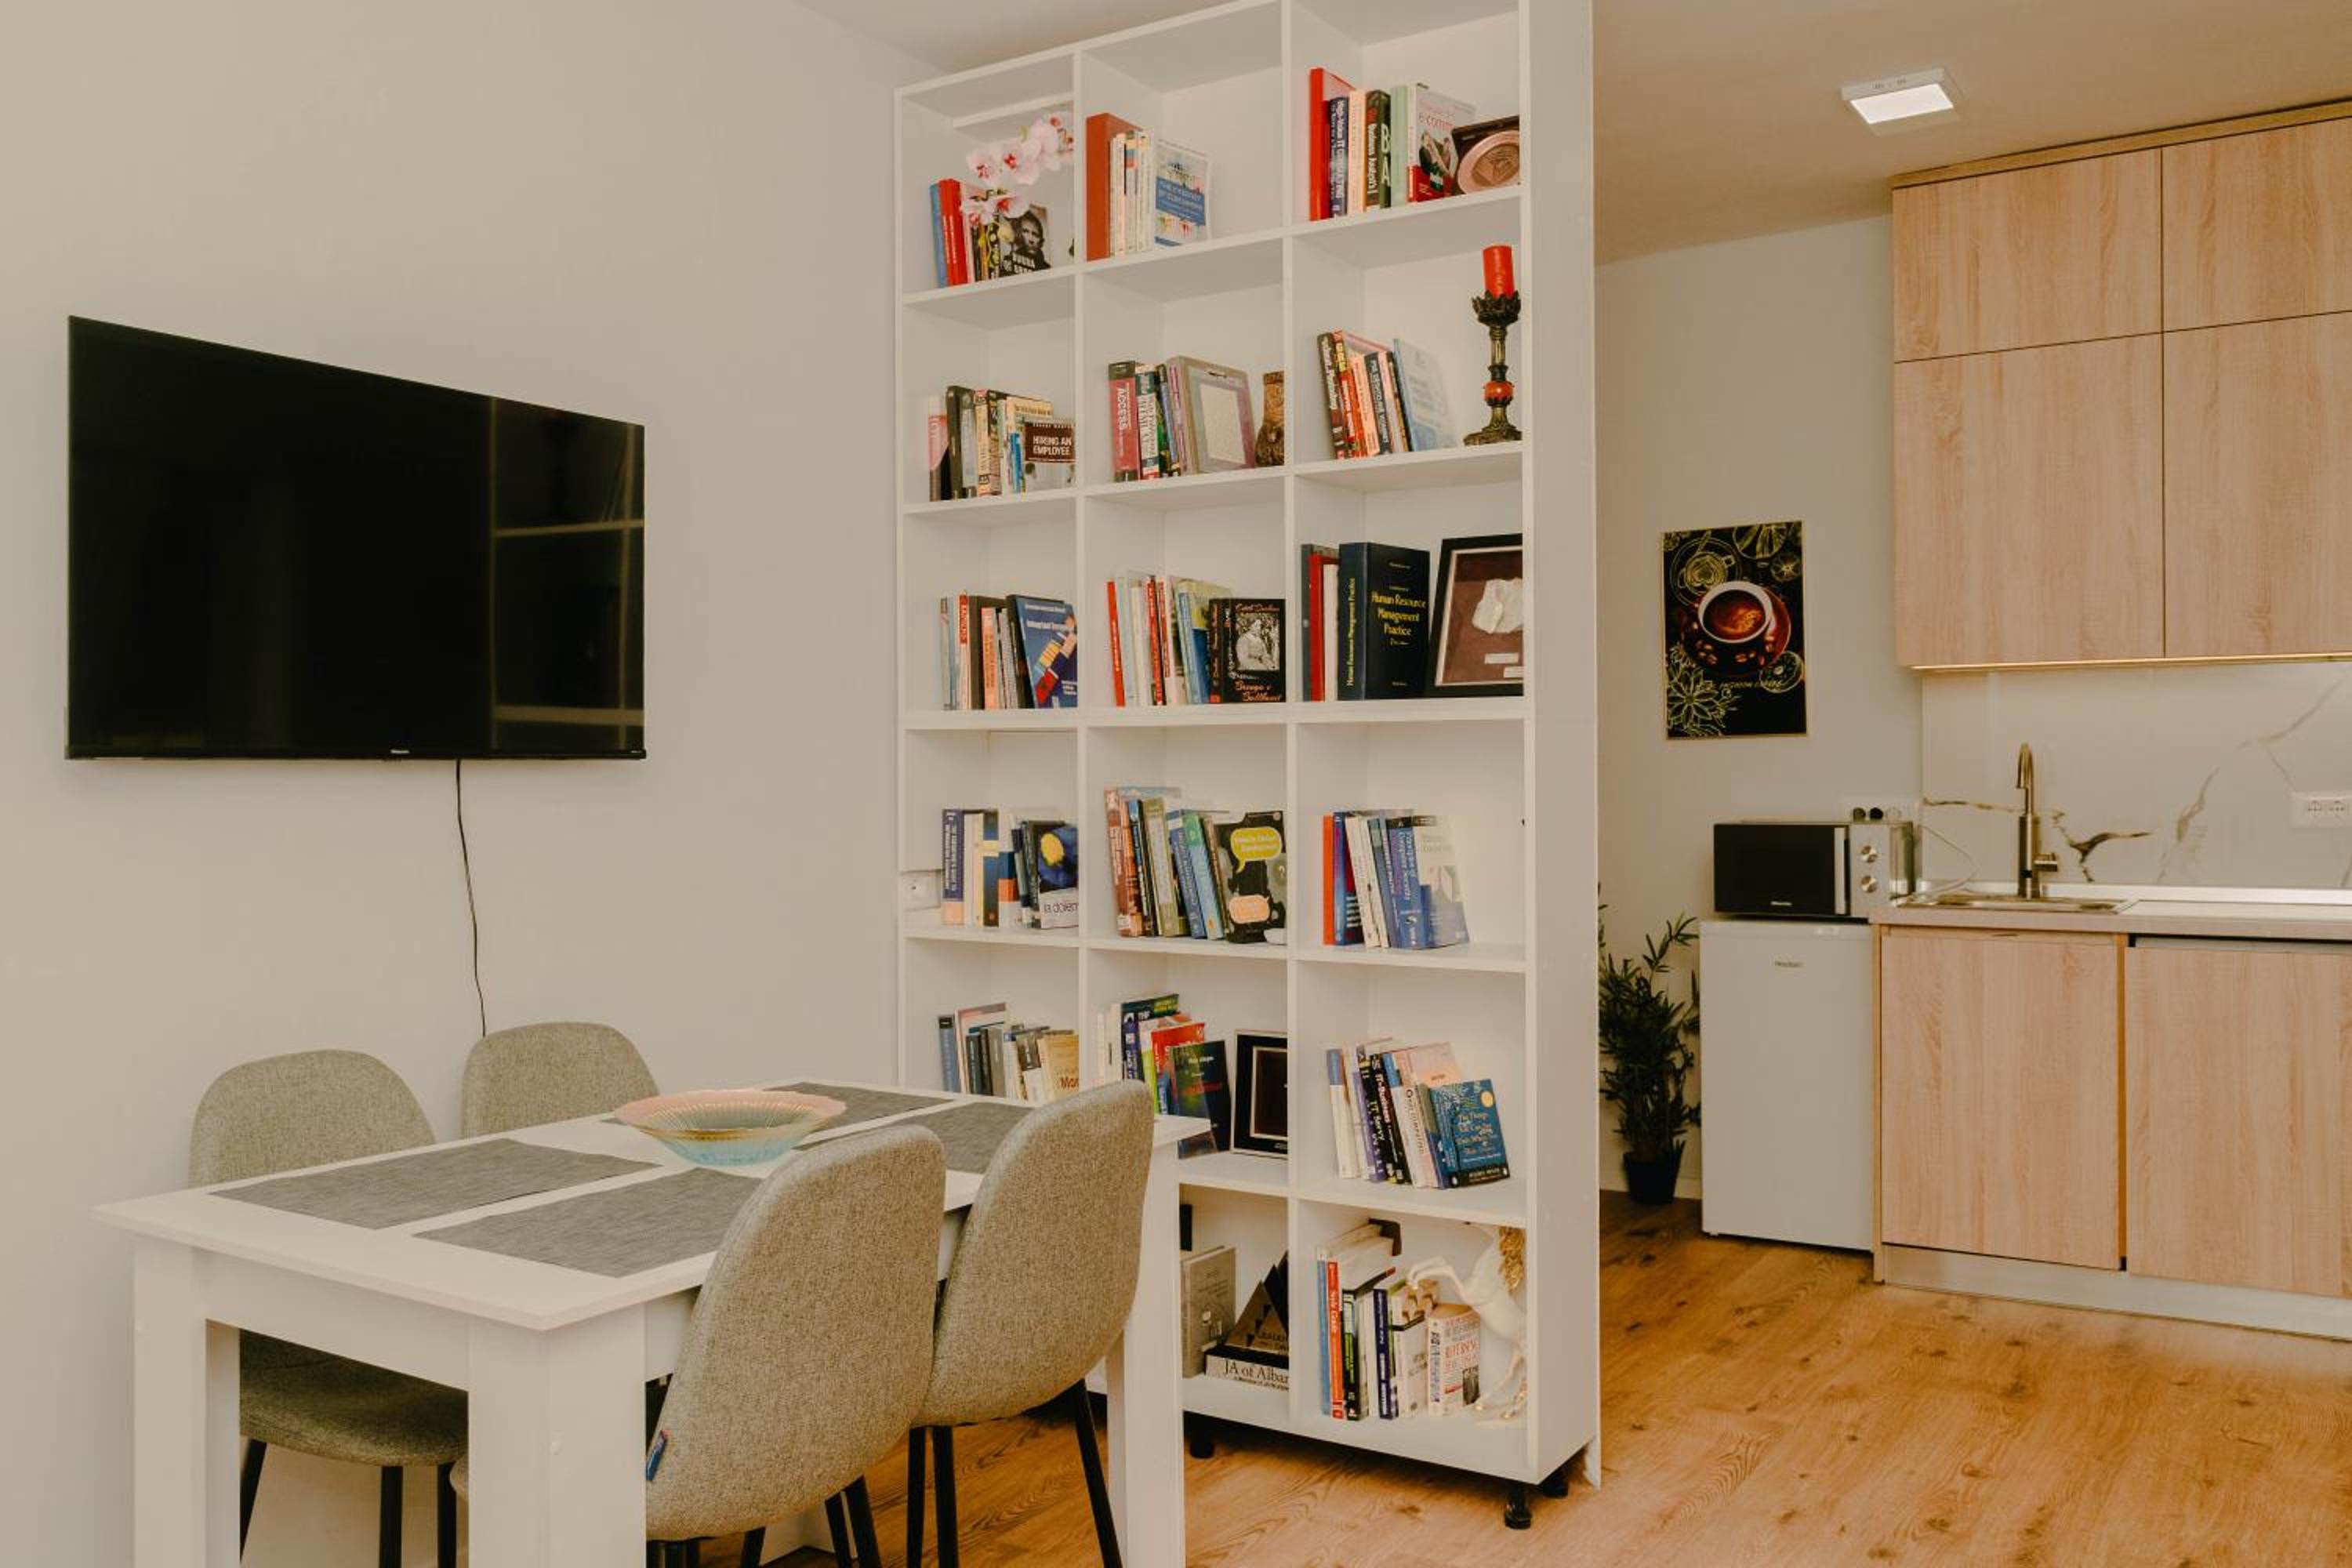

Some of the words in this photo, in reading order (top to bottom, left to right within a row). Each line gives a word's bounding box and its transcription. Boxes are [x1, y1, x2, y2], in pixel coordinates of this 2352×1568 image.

[1033, 436, 1058, 445] HIRING
[1061, 437, 1072, 445] AN
[1033, 447, 1070, 456] EMPLOYEE
[1371, 590, 1395, 605] Human
[1395, 593, 1426, 608] Resource
[1378, 608, 1420, 622] Management
[1384, 622, 1411, 637] Practice
